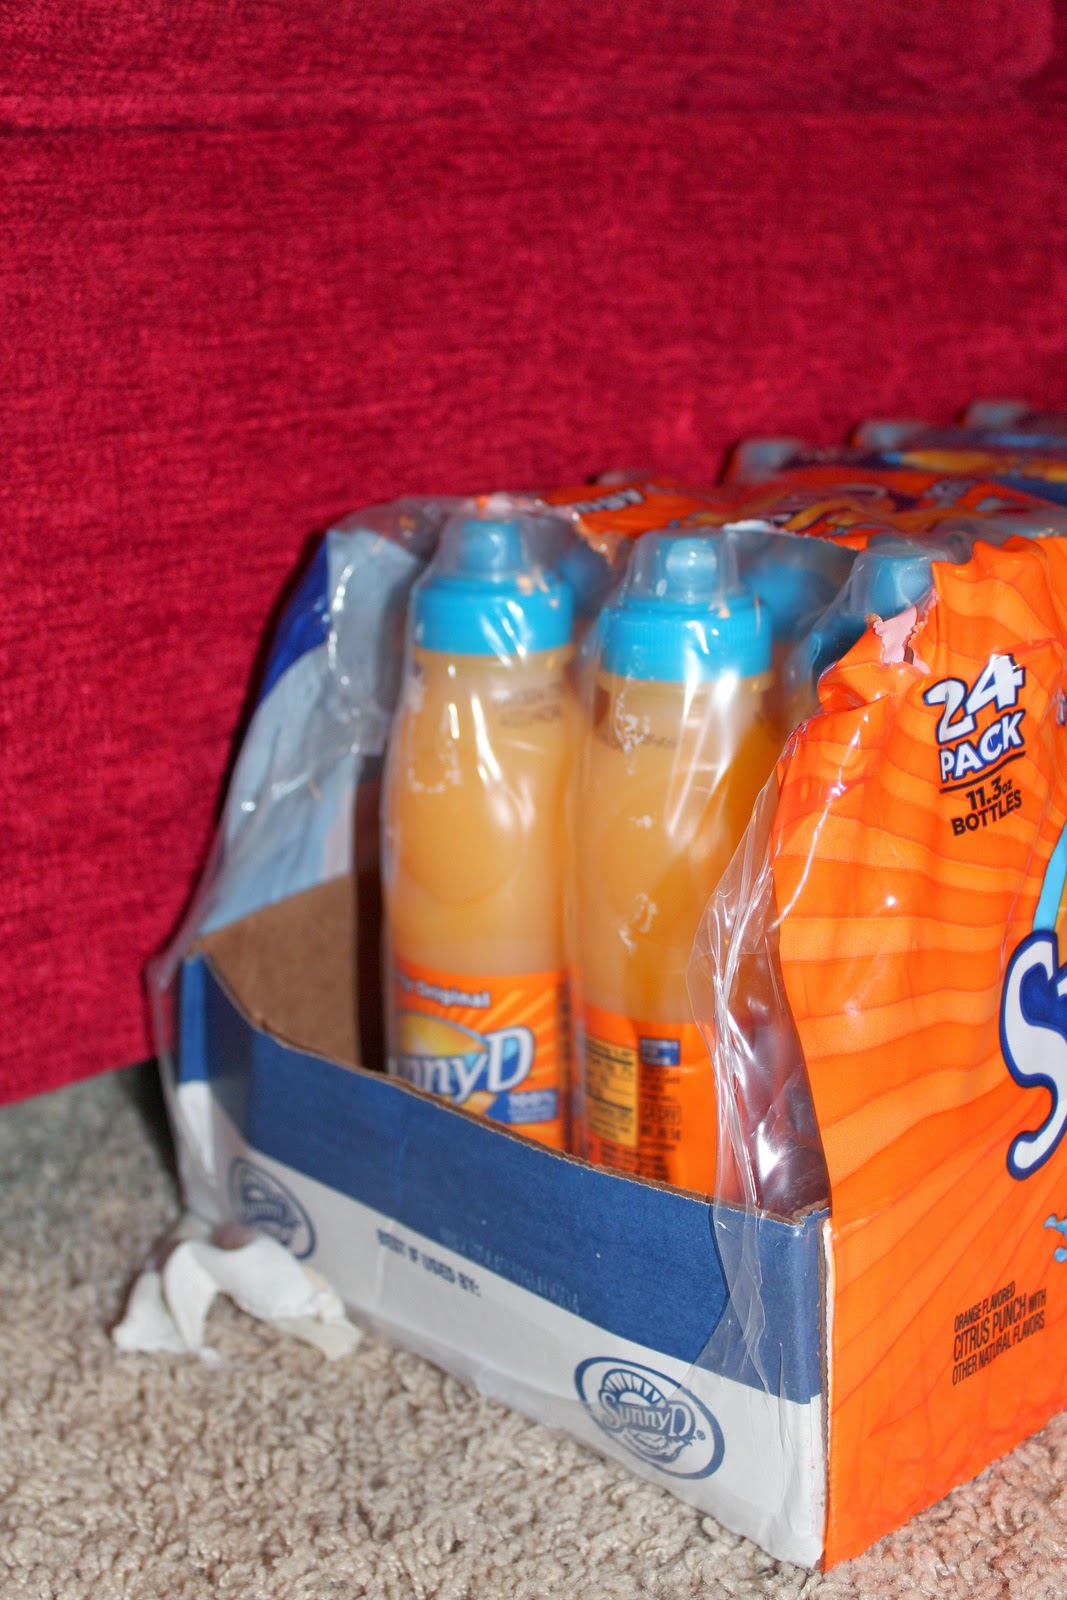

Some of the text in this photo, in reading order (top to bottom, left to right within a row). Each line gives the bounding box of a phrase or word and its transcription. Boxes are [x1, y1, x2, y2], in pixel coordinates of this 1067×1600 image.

[922, 653, 1026, 745] 24
[938, 709, 1027, 783] PACK
[951, 789, 1022, 836] BOTTLES
[421, 1253, 456, 1284] USED
[953, 1287, 1047, 1363] CITRUS PUNCH WITH
[954, 1280, 1016, 1333] ORANGE FLAVORED
[952, 1309, 1046, 1386] OTHER NATURAL FLAVORS
[599, 1388, 695, 1439] SunnyD
